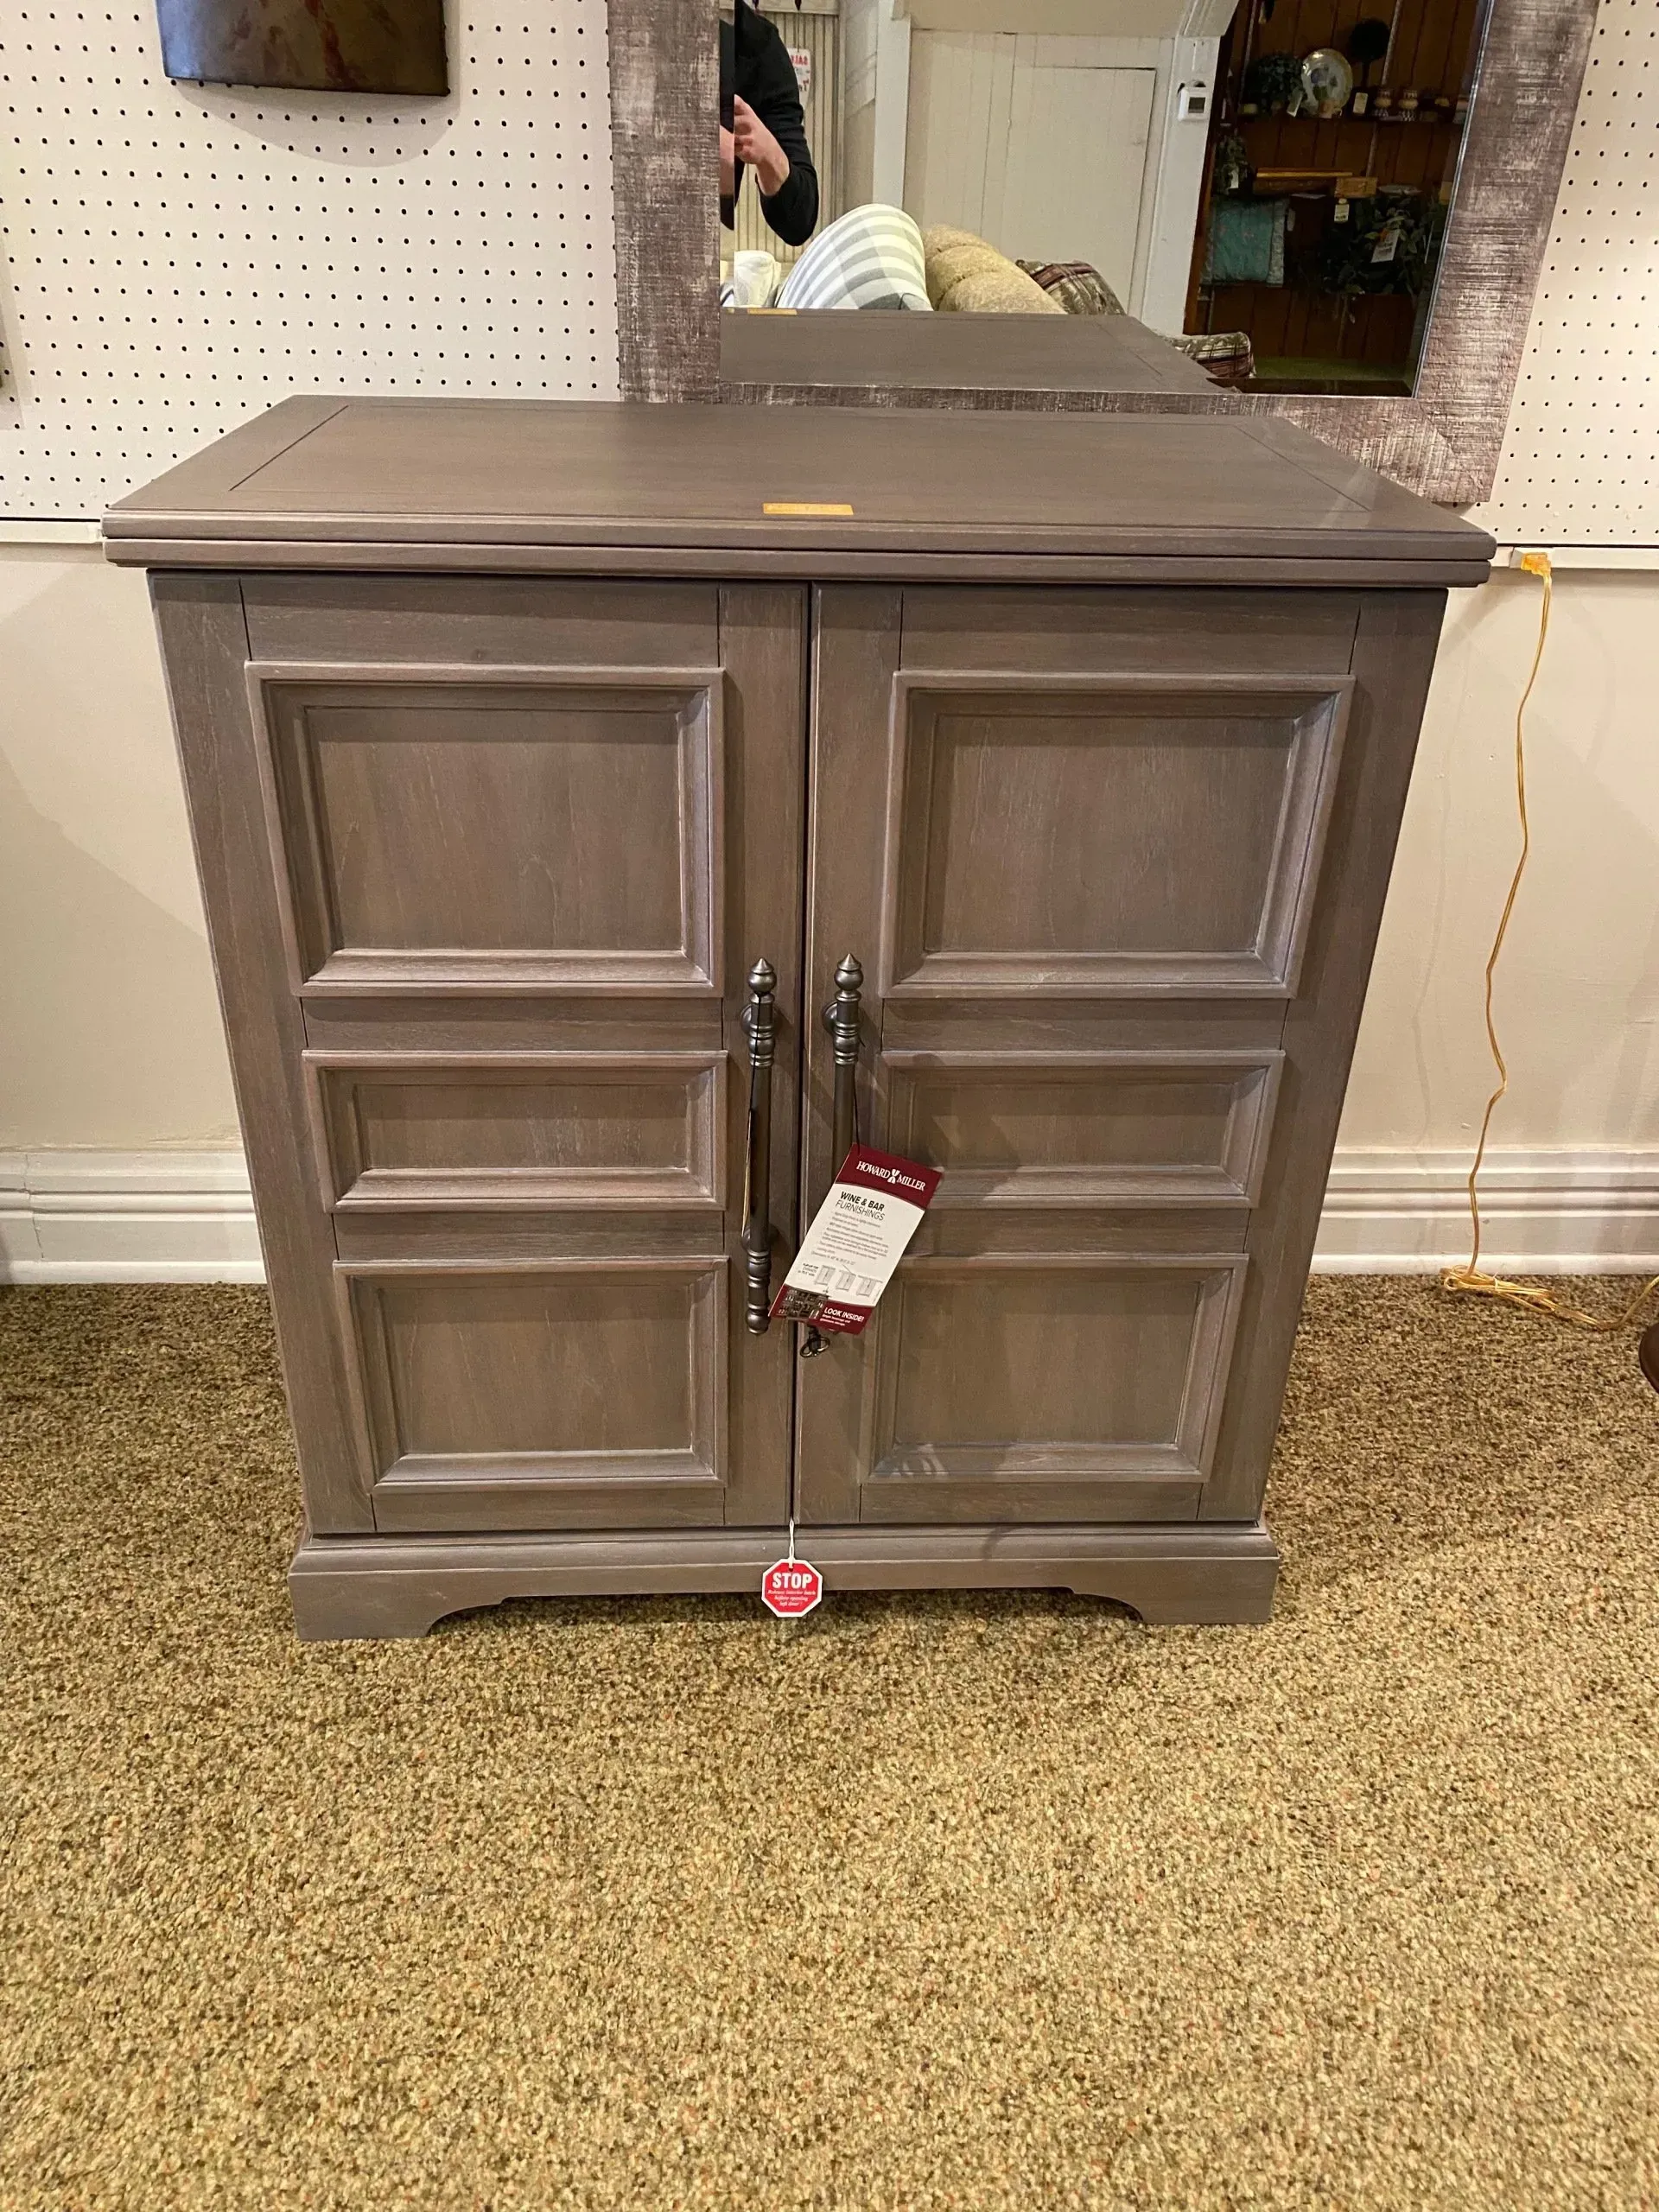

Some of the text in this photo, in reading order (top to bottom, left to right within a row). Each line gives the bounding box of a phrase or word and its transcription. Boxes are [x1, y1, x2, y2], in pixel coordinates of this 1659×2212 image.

[856, 1160, 926, 1192] HOWARD MILLER
[835, 1199, 886, 1221] FURNISHINGS
[840, 1191, 861, 1204] WINE
[868, 1200, 885, 1212] BAR
[823, 1306, 842, 1318] LOOK
[842, 1310, 864, 1322] INSIDE!
[772, 1572, 813, 1589] STOP
